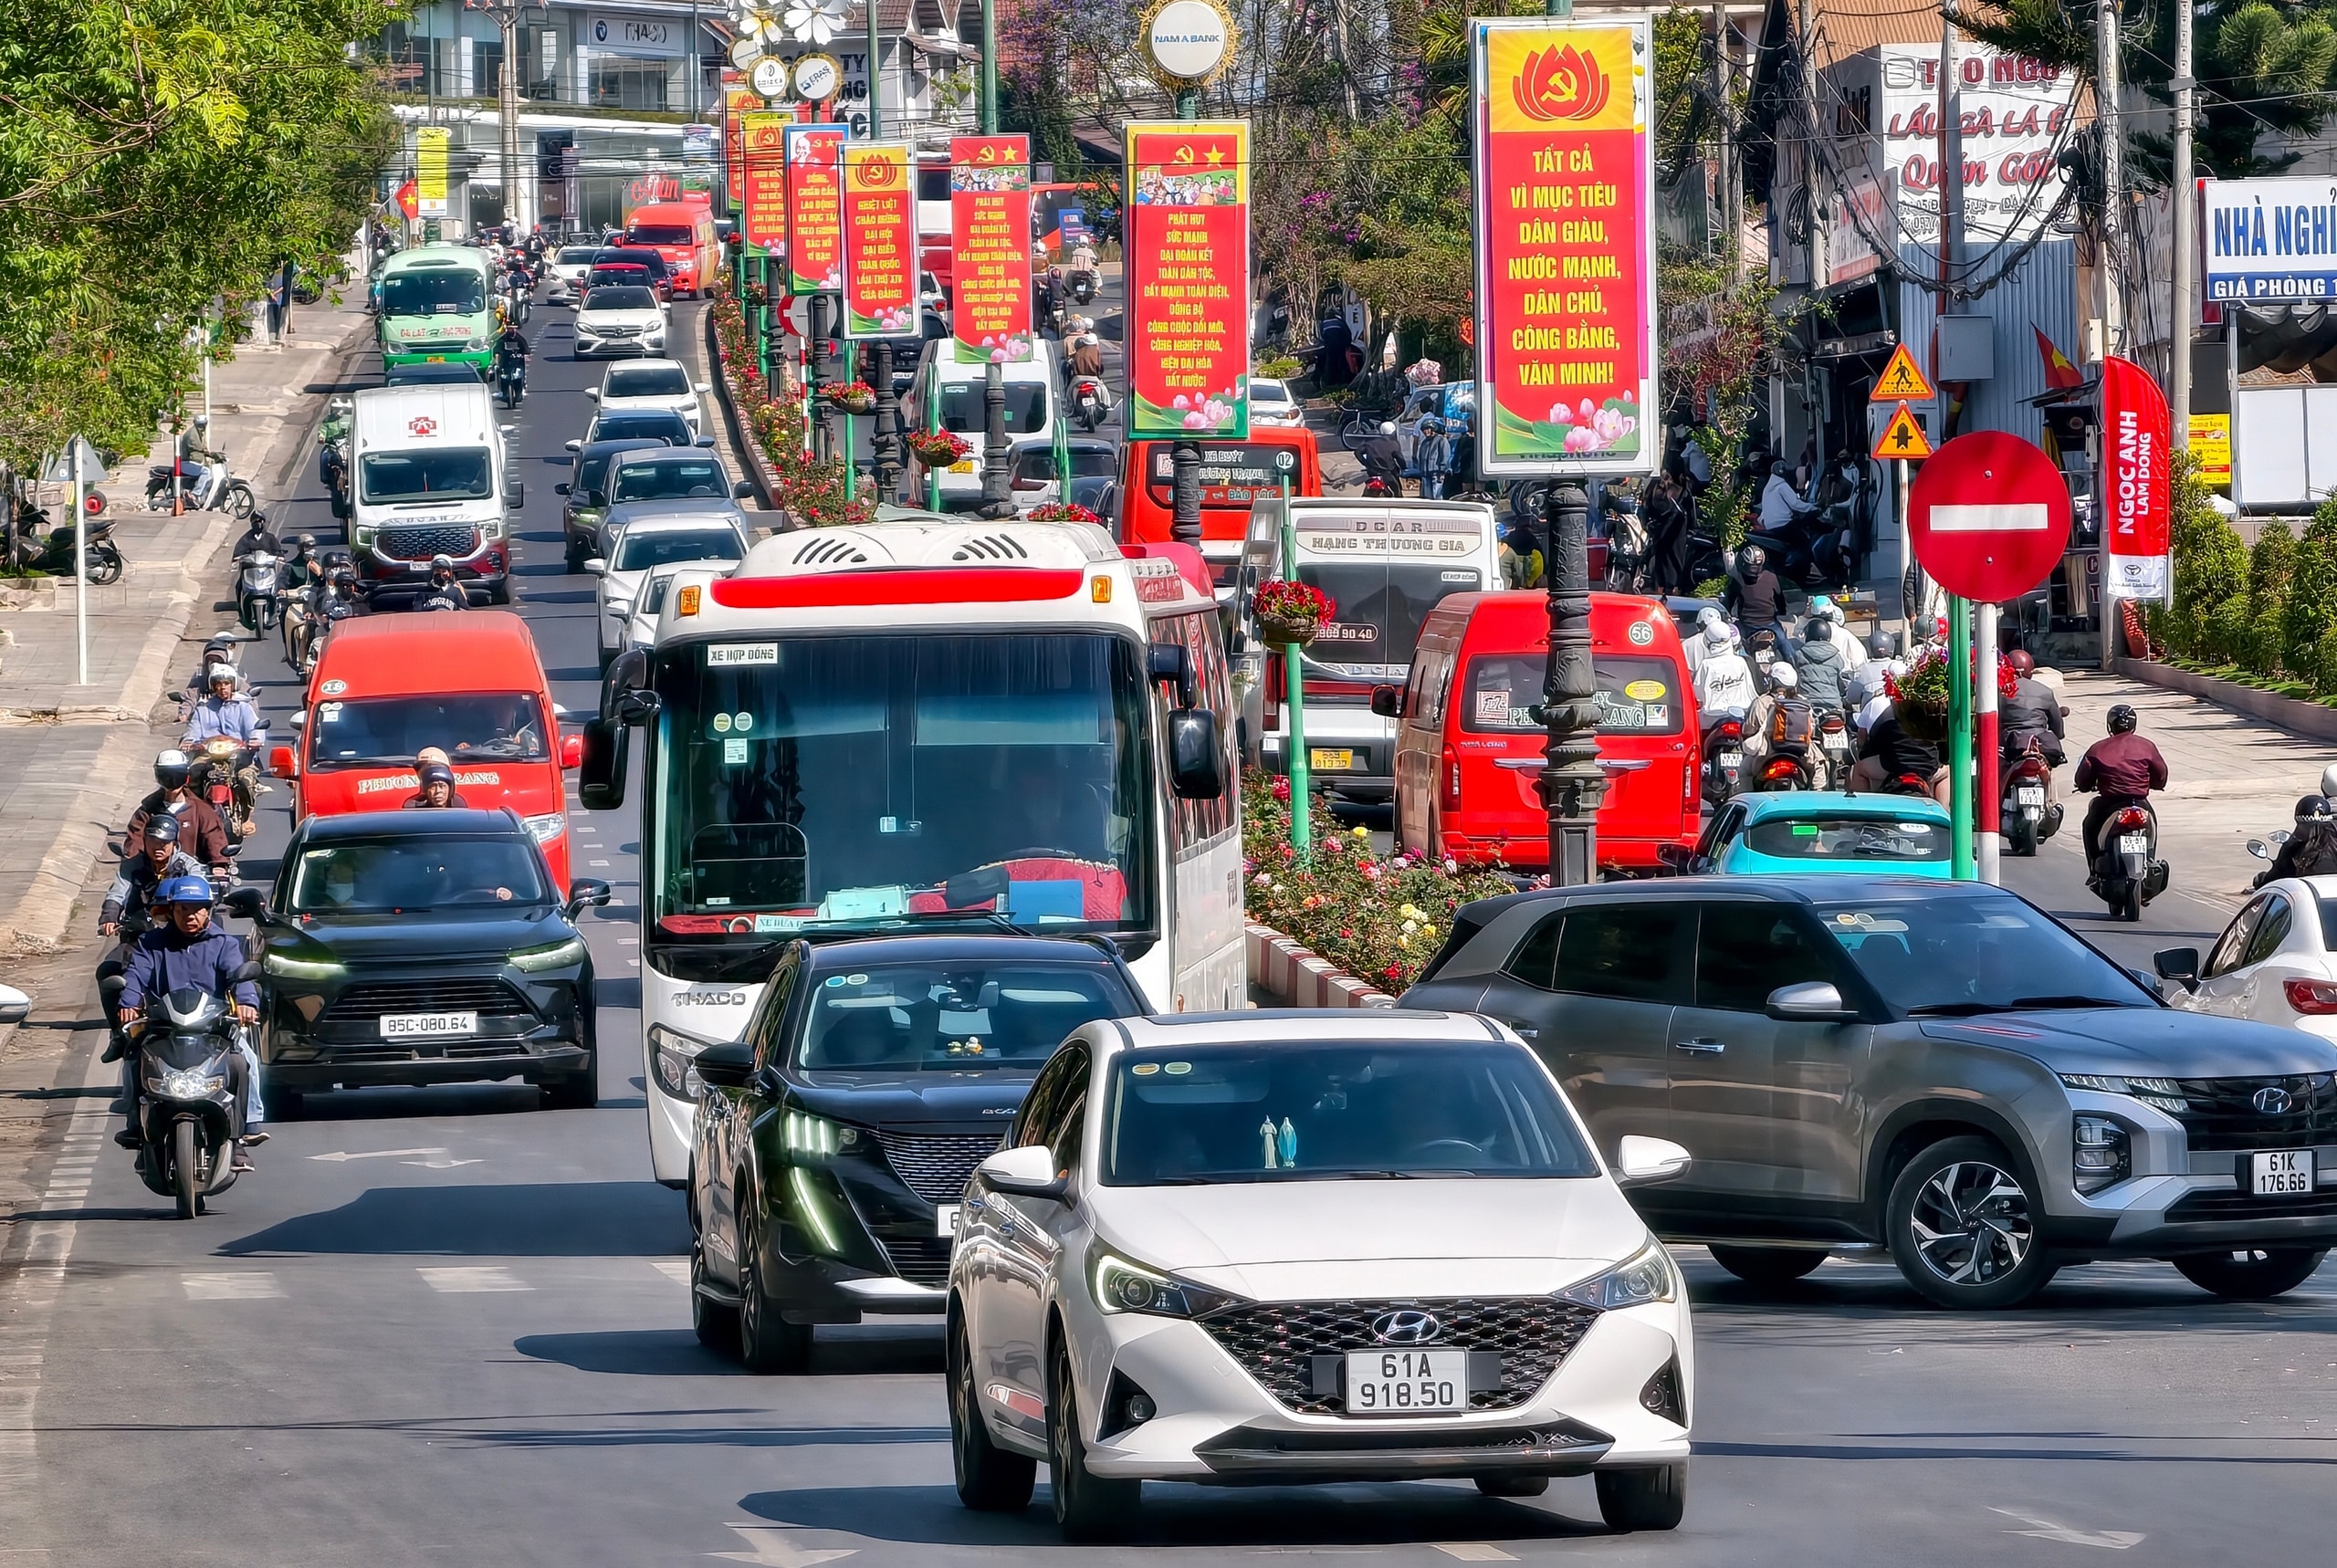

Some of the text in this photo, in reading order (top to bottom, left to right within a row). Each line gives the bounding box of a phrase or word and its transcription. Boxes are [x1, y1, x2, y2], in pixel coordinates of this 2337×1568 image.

[1155, 35, 1220, 43] NAM A BANK
[1533, 141, 1594, 172] TẤT CẢ
[1511, 181, 1617, 213] VÌ MỤC TIÊU
[1168, 211, 1205, 225] PHÁT HUY
[2214, 186, 2337, 256] NHÀ NGHỈ
[1166, 228, 1208, 246] SỨC MẠNH
[1519, 216, 1609, 245] DÂN GIÀU,
[1198, 246, 1213, 262] KẾT
[1158, 265, 1179, 279] TOÀN
[1179, 265, 1197, 279] DÂN
[1508, 253, 1622, 283] NƯỚC MẠNH,
[1186, 283, 1207, 297] TOÀN
[2214, 276, 2248, 298] GIÁ
[2254, 274, 2326, 297] PHÒNG
[1524, 284, 1608, 315] DÂN CHỦ,
[1192, 301, 1204, 319] BỘ
[1147, 319, 1168, 333] CÔNG
[1169, 319, 1192, 336] CUỘC
[1512, 319, 1620, 351] CÔNG BẰNG,
[1150, 337, 1172, 351] CÔNG
[1518, 359, 1614, 386] VĂN MINH!
[2119, 411, 2138, 464] ANH
[1277, 454, 1292, 466] 02
[2136, 432, 2152, 516] LAM DONG
[1312, 537, 1357, 551] HẠNG
[1439, 538, 1465, 551] GIA
[1631, 626, 1652, 641] 56
[710, 650, 724, 661] XE
[727, 649, 745, 664] HỢP
[1598, 706, 1645, 727] ANG
[455, 772, 499, 785] RANG
[671, 992, 746, 1008] THACO
[388, 1017, 468, 1032] 85C-080.64
[2269, 1153, 2296, 1172] 61K
[2260, 1172, 2306, 1193] 176.66
[1381, 1354, 1432, 1378] 61A
[1360, 1381, 1454, 1407] 918.50
